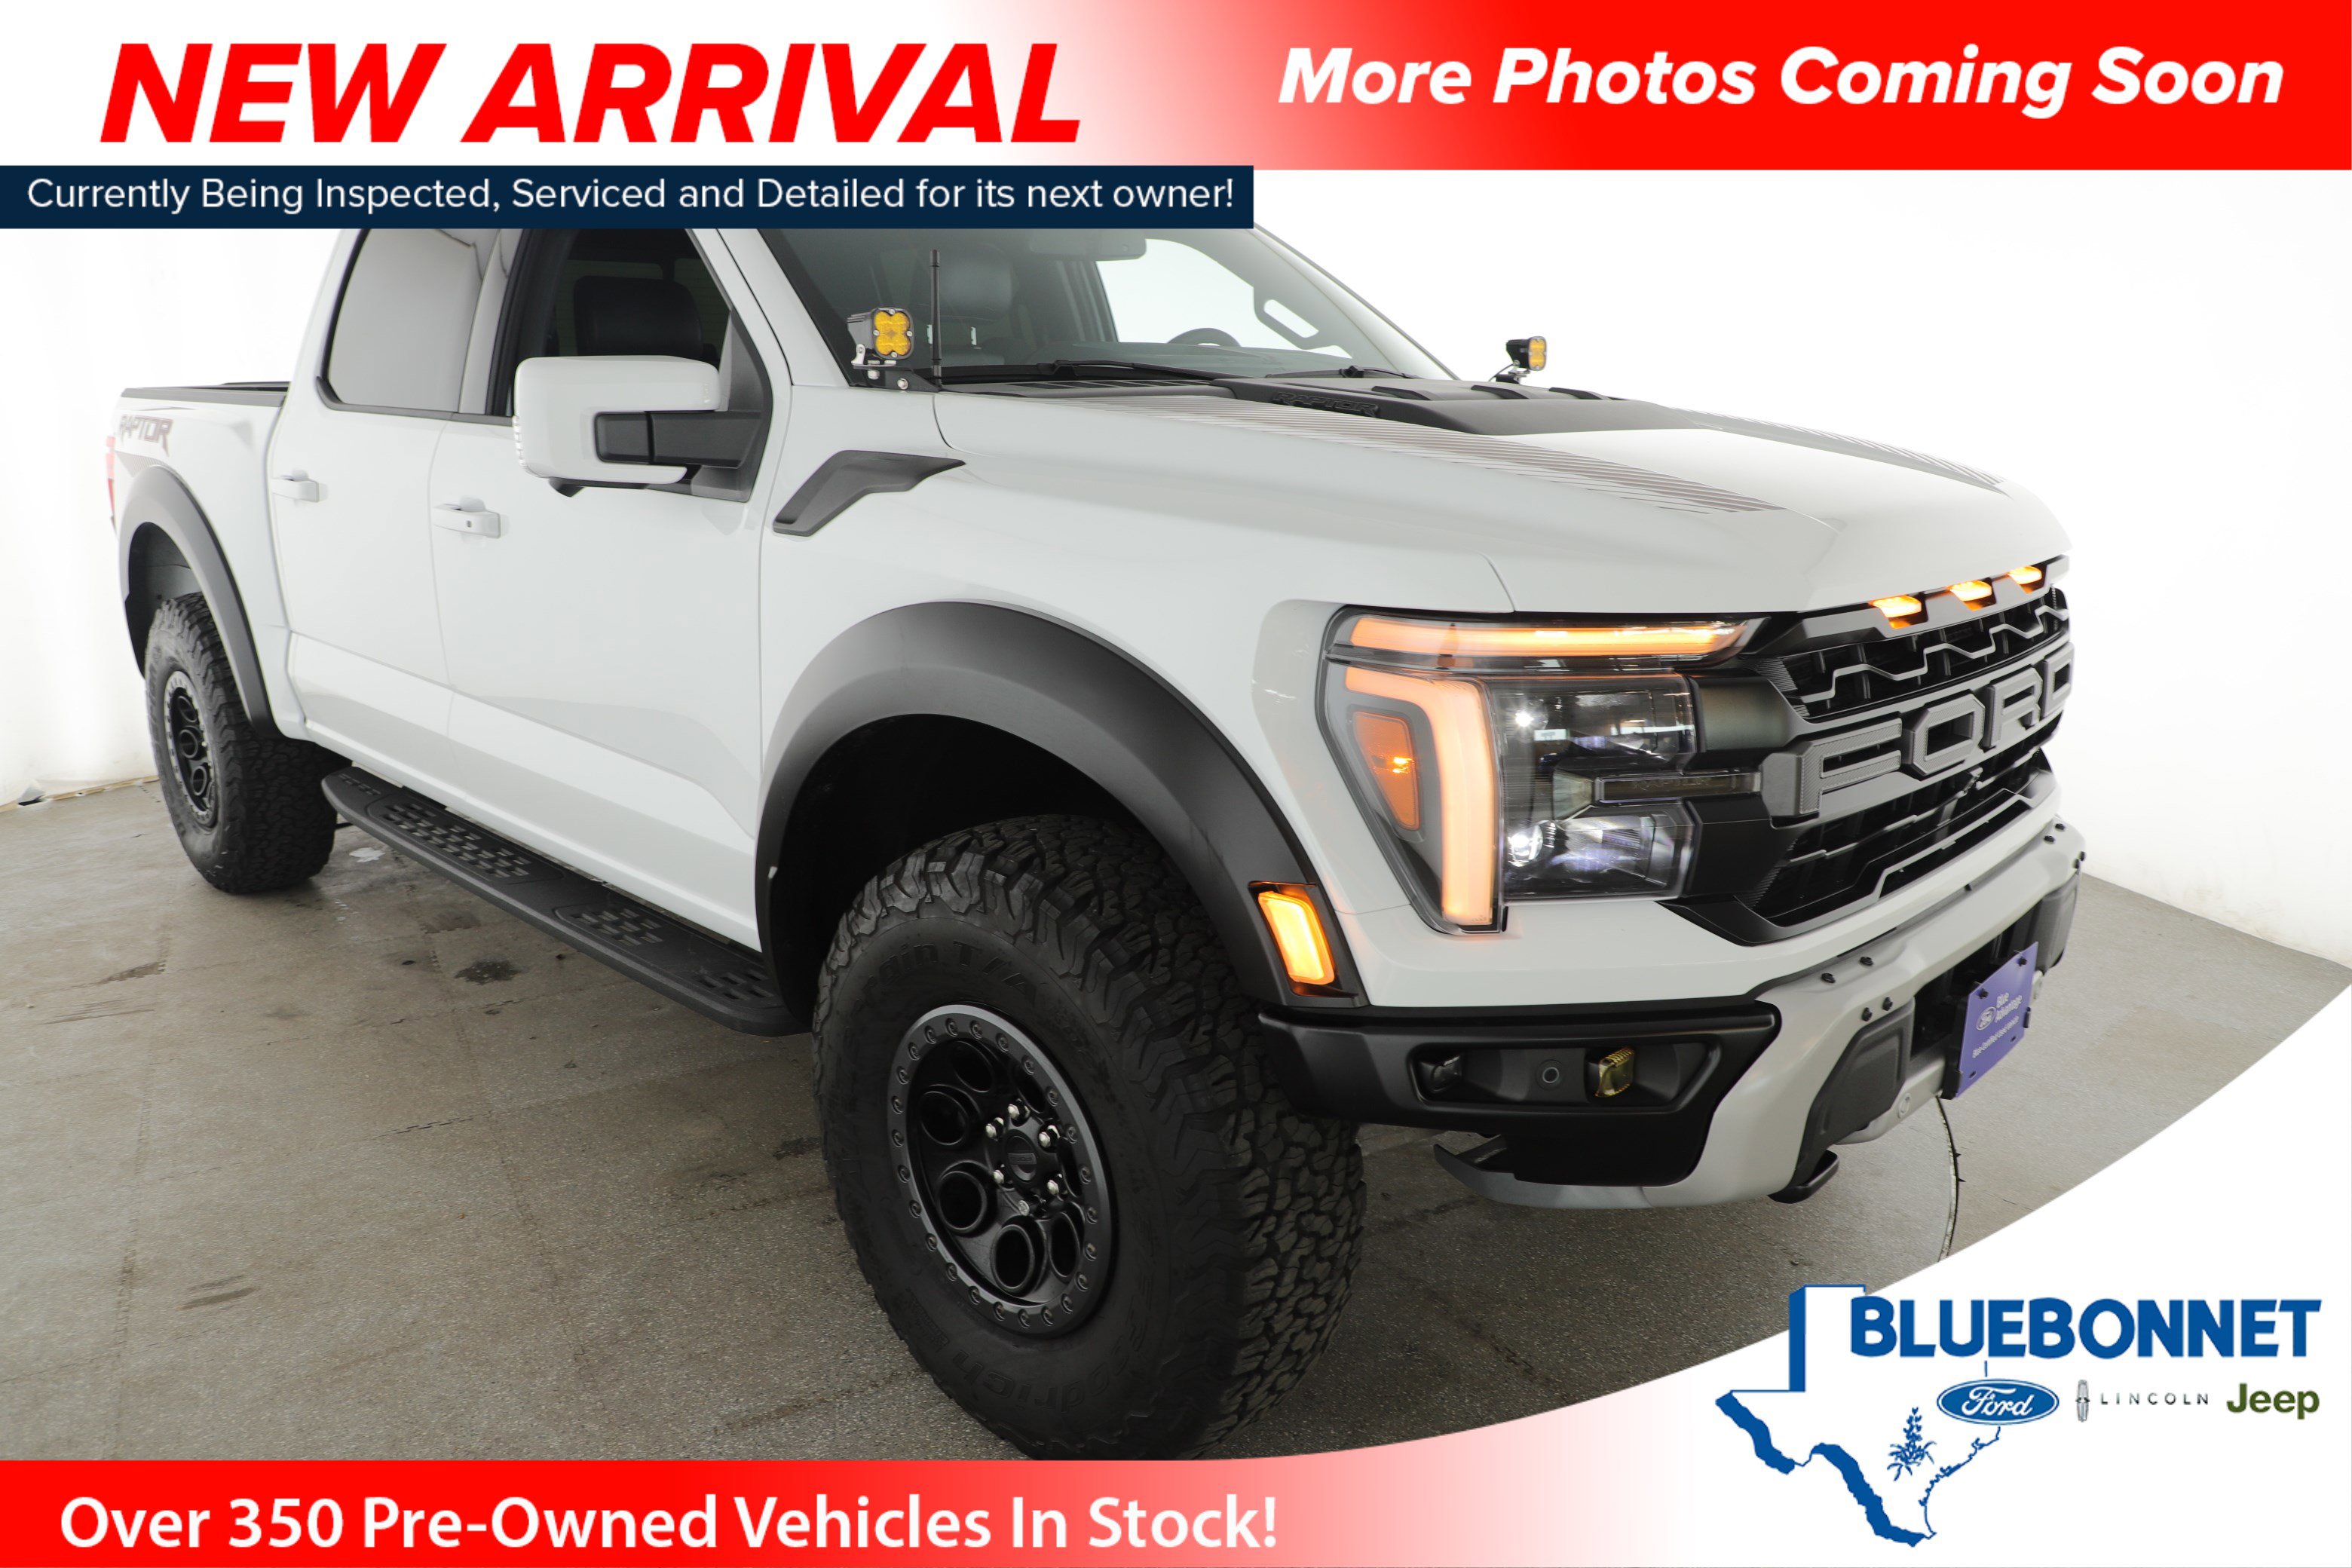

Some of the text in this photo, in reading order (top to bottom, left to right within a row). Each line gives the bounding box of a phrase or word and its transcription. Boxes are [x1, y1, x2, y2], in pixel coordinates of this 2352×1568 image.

[1271, 391, 1380, 418] RAPTOR
[120, 414, 173, 458] RAPTOR
[1798, 641, 2074, 816] FORD
